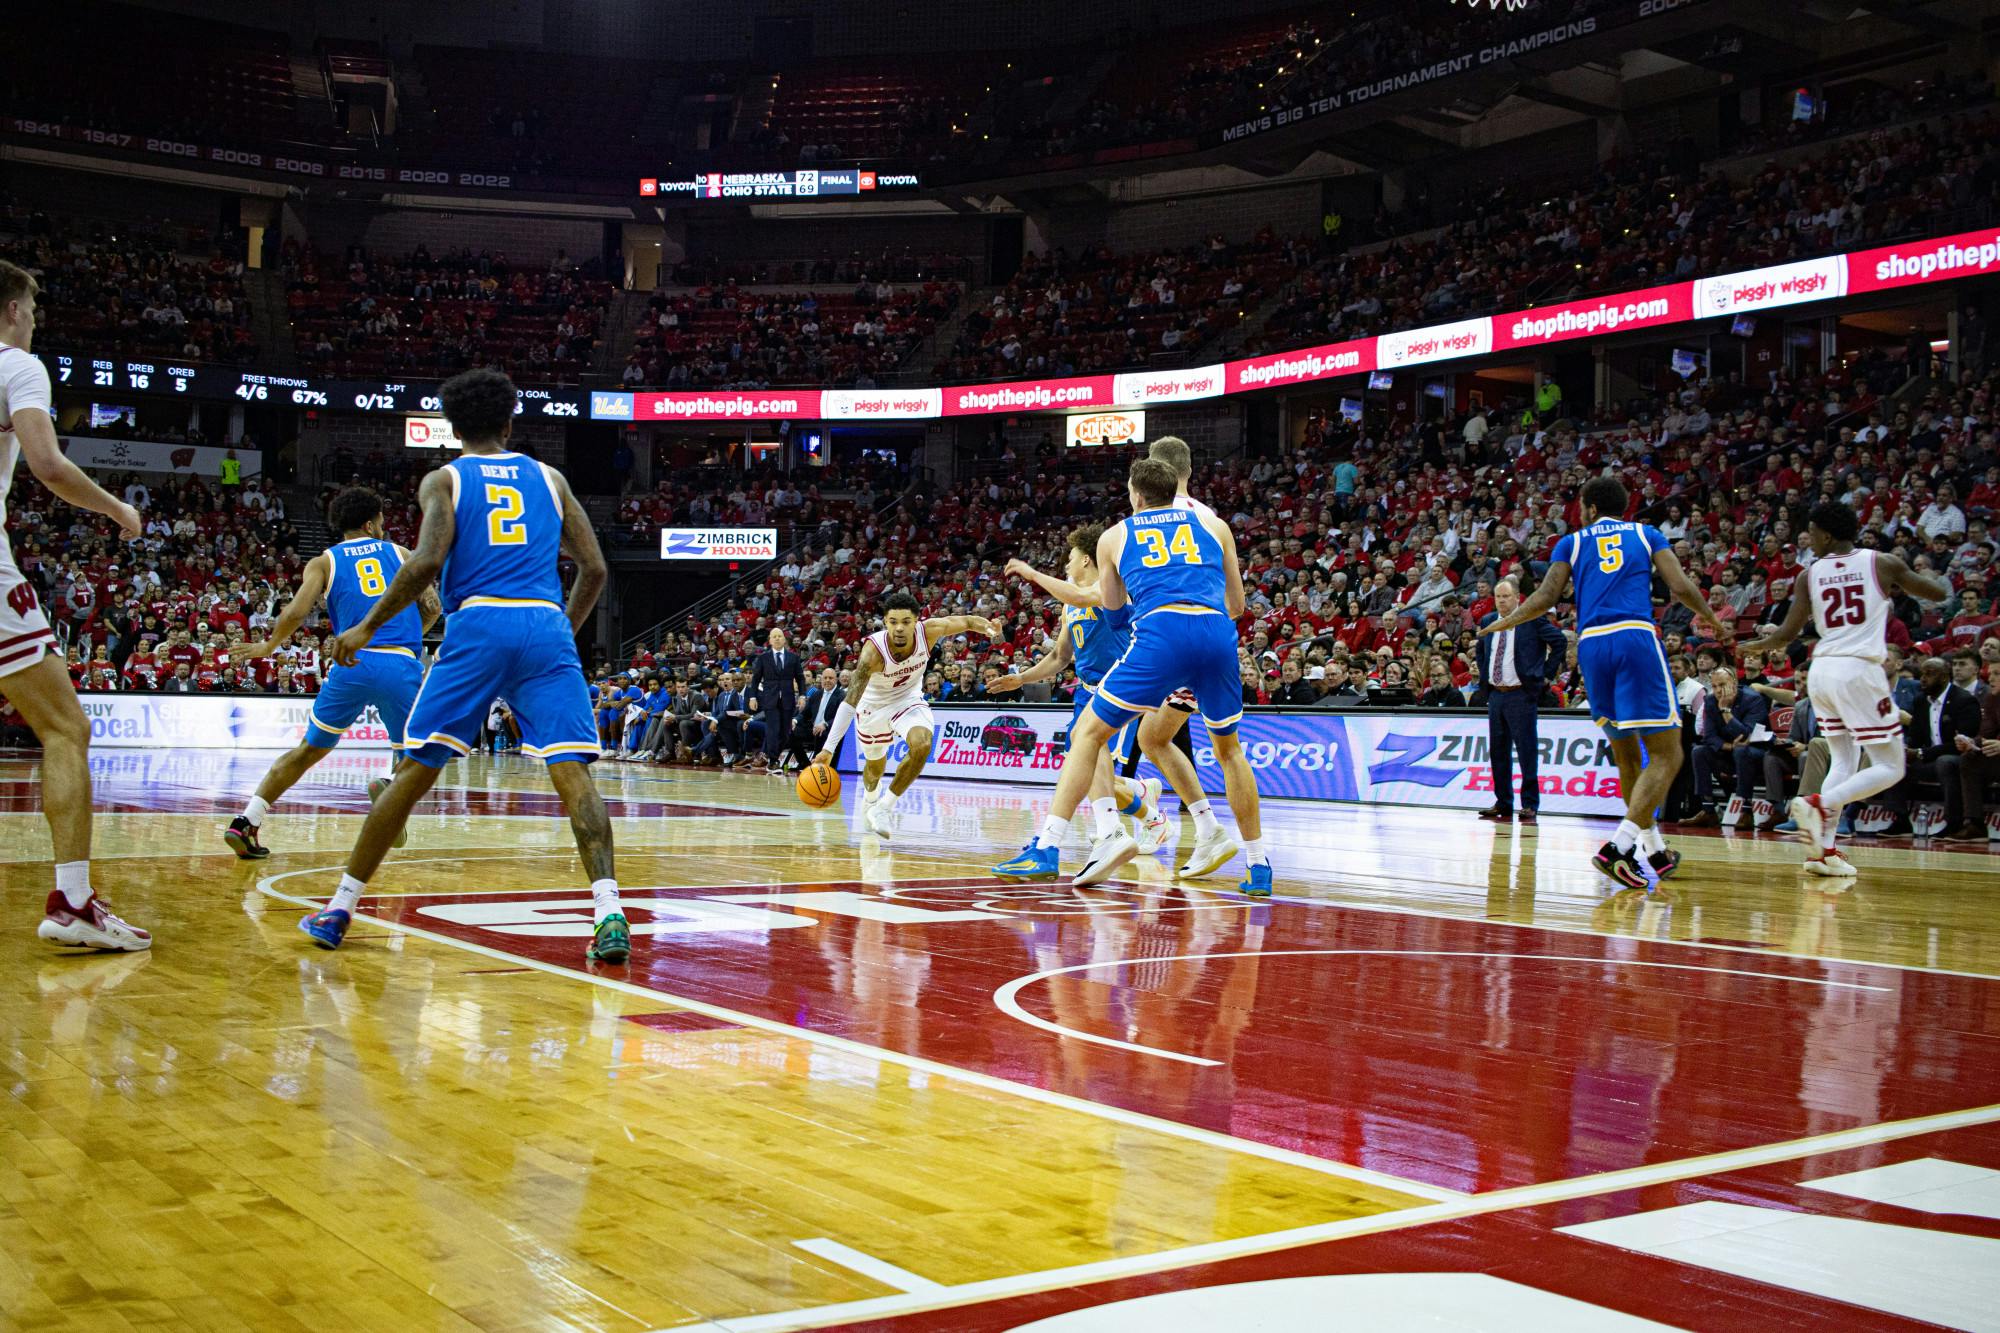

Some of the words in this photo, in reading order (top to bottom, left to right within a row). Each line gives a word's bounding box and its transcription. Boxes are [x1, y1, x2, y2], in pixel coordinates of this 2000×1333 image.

[1222, 116, 1271, 142] MEN'S
[1276, 106, 1304, 126] BIG
[1309, 94, 1342, 115] TEN
[1347, 55, 1473, 104] TOURNAMENT
[1479, 17, 1597, 65] CHAMPIONS
[13, 118, 62, 137] 1941
[82, 128, 132, 147] 1947
[145, 138, 199, 157] 2002
[211, 147, 263, 167] 2003
[274, 157, 324, 176] 2008
[338, 165, 385, 181] 2015
[398, 169, 449, 184] 2020
[459, 172, 511, 188] 2022
[722, 173, 786, 184] NEBRASKA
[799, 172, 814, 182] 72
[820, 175, 853, 185] FINAL
[878, 175, 918, 185] TOYOTA
[659, 181, 697, 192] TOYOTA
[722, 186, 753, 196] OHIO
[754, 185, 793, 196] STATE
[799, 184, 814, 194] 69
[1733, 281, 1776, 305] piggly
[1780, 272, 1828, 294] wiggly
[1511, 297, 1668, 340] shopthepig.com
[1407, 339, 1440, 356] piggly
[1443, 331, 1478, 348] wiggly
[58, 356, 72, 366] TO
[93, 360, 113, 370] REB
[127, 363, 154, 374] DREB
[168, 367, 195, 377] OREB
[1239, 350, 1360, 385] shopthepig.com
[59, 367, 72, 382] 7
[94, 371, 113, 386] 21
[129, 374, 149, 389] 16
[175, 378, 187, 392] 5
[242, 373, 266, 384] FREE
[268, 376, 308, 388] THROWS
[384, 384, 406, 393] 3-PT
[1145, 380, 1179, 397] piggly
[1184, 376, 1214, 392] wiggly
[235, 384, 268, 401] 4/6
[292, 389, 328, 406] 67%
[355, 394, 394, 410] 0/12
[525, 390, 552, 399] GOAL
[959, 385, 1093, 410] shopthepig.com
[542, 402, 579, 416] 42%
[653, 396, 798, 417] shopthepig.com
[854, 399, 890, 413] piggly
[893, 399, 929, 413] wiggly
[1080, 418, 1132, 440] COUSINS
[479, 464, 519, 480] DENT
[484, 482, 528, 546] 2
[697, 533, 772, 544] ZIMBRICK
[1590, 523, 1635, 537] WILLIAMS
[343, 542, 383, 557] FREENY
[711, 546, 772, 555] HONDA
[1134, 523, 1203, 569] 34
[1595, 533, 1624, 575] 5
[354, 557, 388, 598] 8
[1818, 572, 1864, 586] BLACKWELL
[1822, 584, 1866, 629] 25
[1072, 623, 1085, 649] 0
[883, 660, 926, 678] WISCONSIN
[91, 704, 153, 739] ocal
[943, 720, 980, 744] Shop
[937, 739, 1025, 769] Zimbrick
